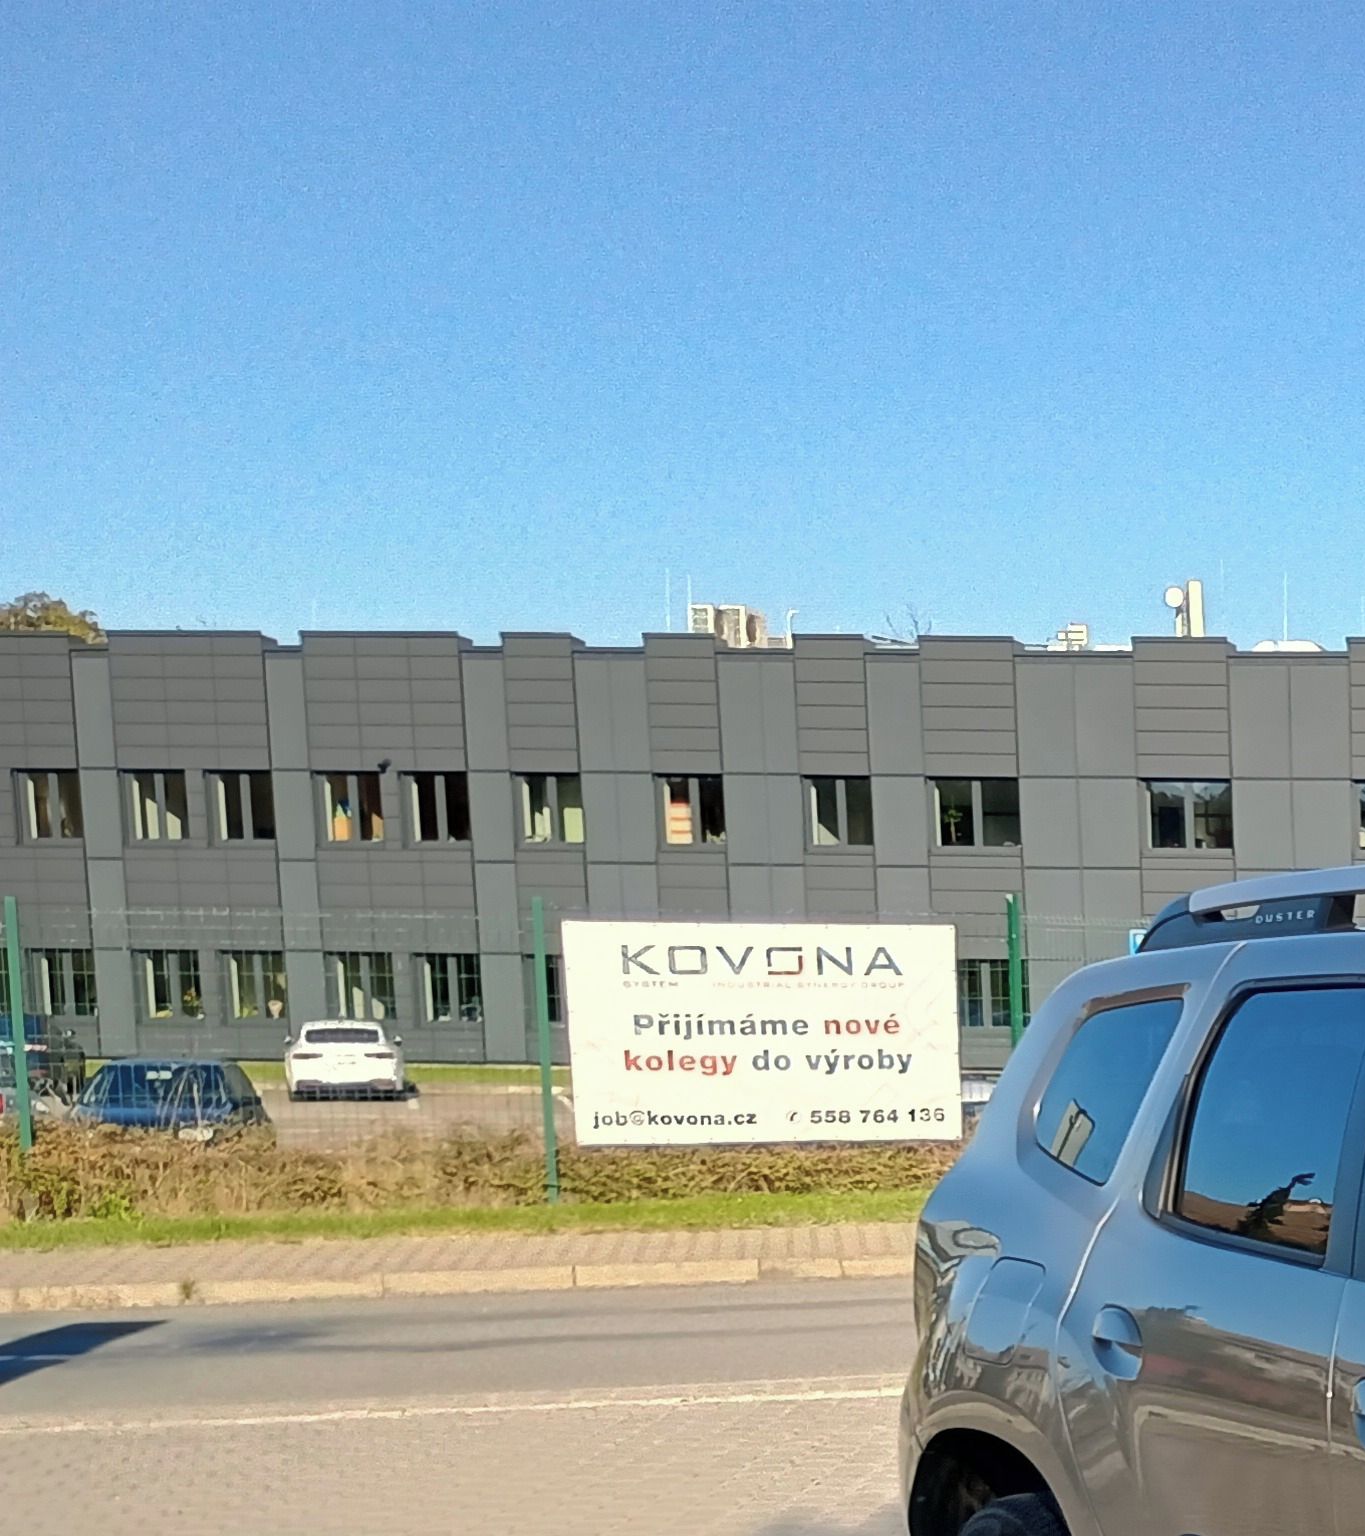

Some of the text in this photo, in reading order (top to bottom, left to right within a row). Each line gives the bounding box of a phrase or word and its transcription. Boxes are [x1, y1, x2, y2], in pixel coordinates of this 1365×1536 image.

[1255, 909, 1316, 925] DUSTER
[620, 944, 904, 976] KOVONA
[633, 1013, 901, 1040] Přijímáme nové
[623, 1048, 913, 1076] kolegy do výroby
[593, 1108, 945, 1130] job@kovona.cz 558 764 136
